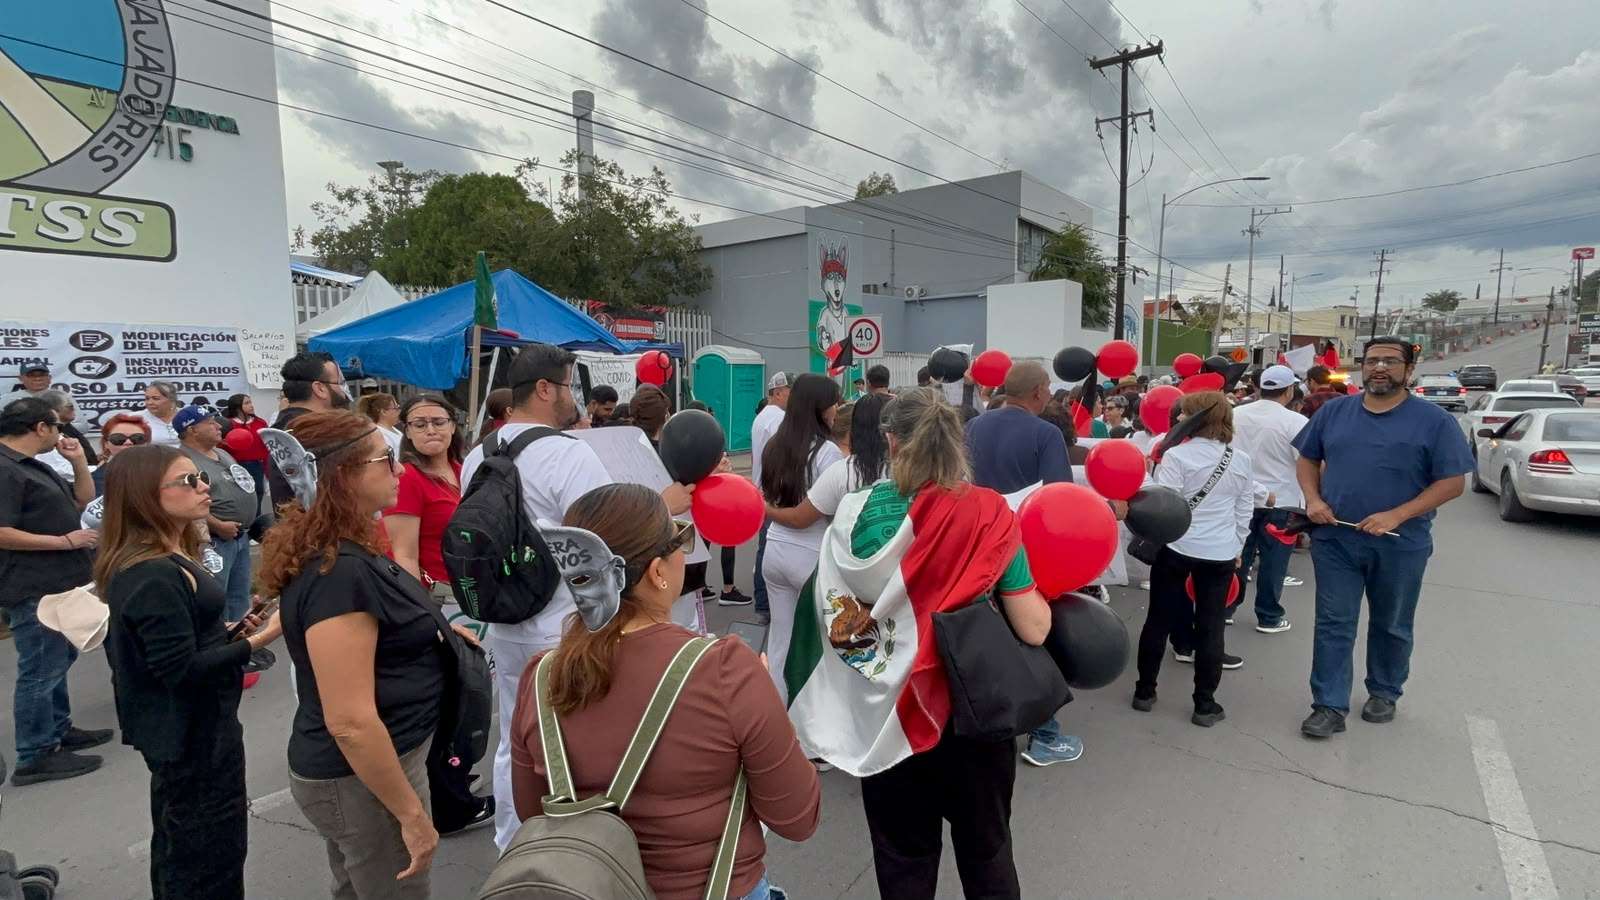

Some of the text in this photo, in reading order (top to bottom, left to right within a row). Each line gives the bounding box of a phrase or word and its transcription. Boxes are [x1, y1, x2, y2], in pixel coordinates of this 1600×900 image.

[122, 331, 236, 342] MODIFICACIÓN
[856, 327, 872, 341] 40
[123, 341, 204, 351] DEL RJP
[125, 358, 199, 367] INSUMOS
[126, 366, 240, 375] HOSPITALARIOS
